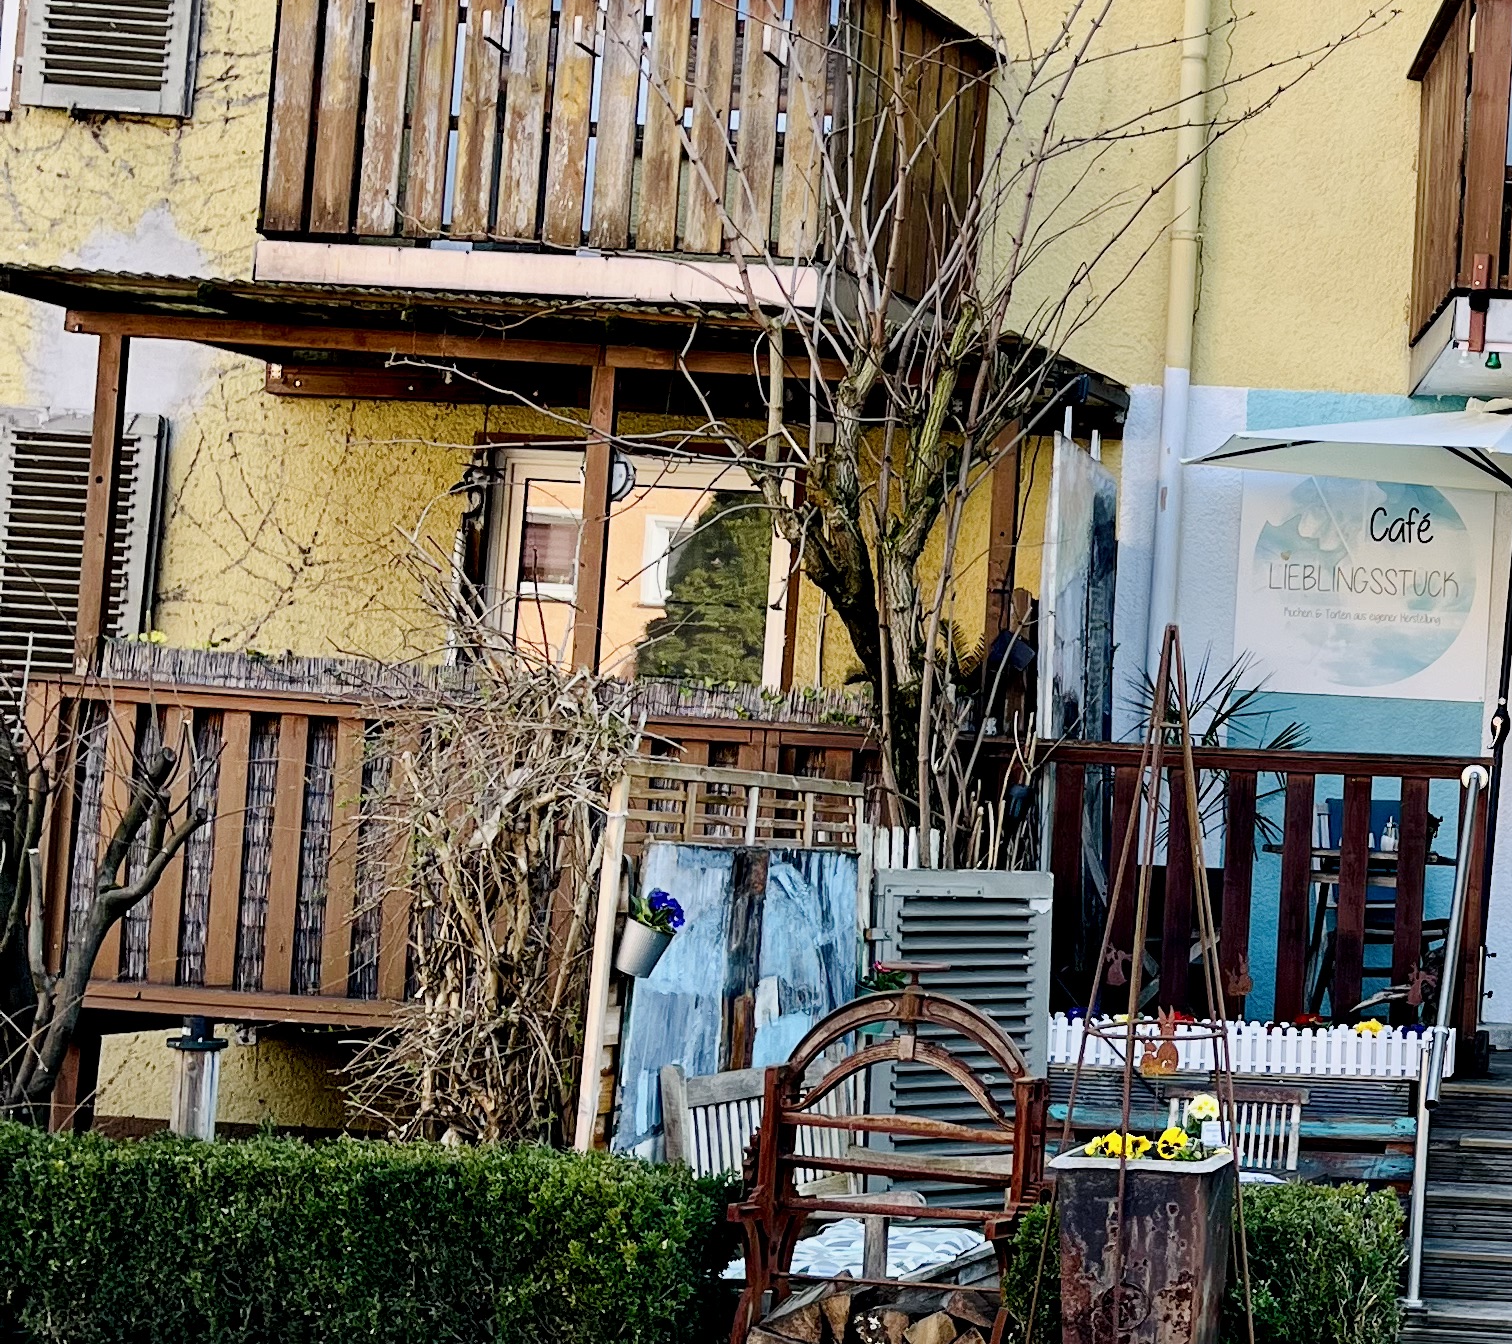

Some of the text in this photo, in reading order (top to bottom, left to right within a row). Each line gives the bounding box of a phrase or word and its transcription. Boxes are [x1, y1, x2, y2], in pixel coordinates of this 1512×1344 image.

[1370, 506, 1433, 544] Café
[1283, 607, 1312, 618] Kuchen
[1325, 609, 1351, 620] Torten
[1353, 611, 1367, 621] aus
[1369, 612, 1398, 624] eigener
[1400, 612, 1441, 626] Herstellung
